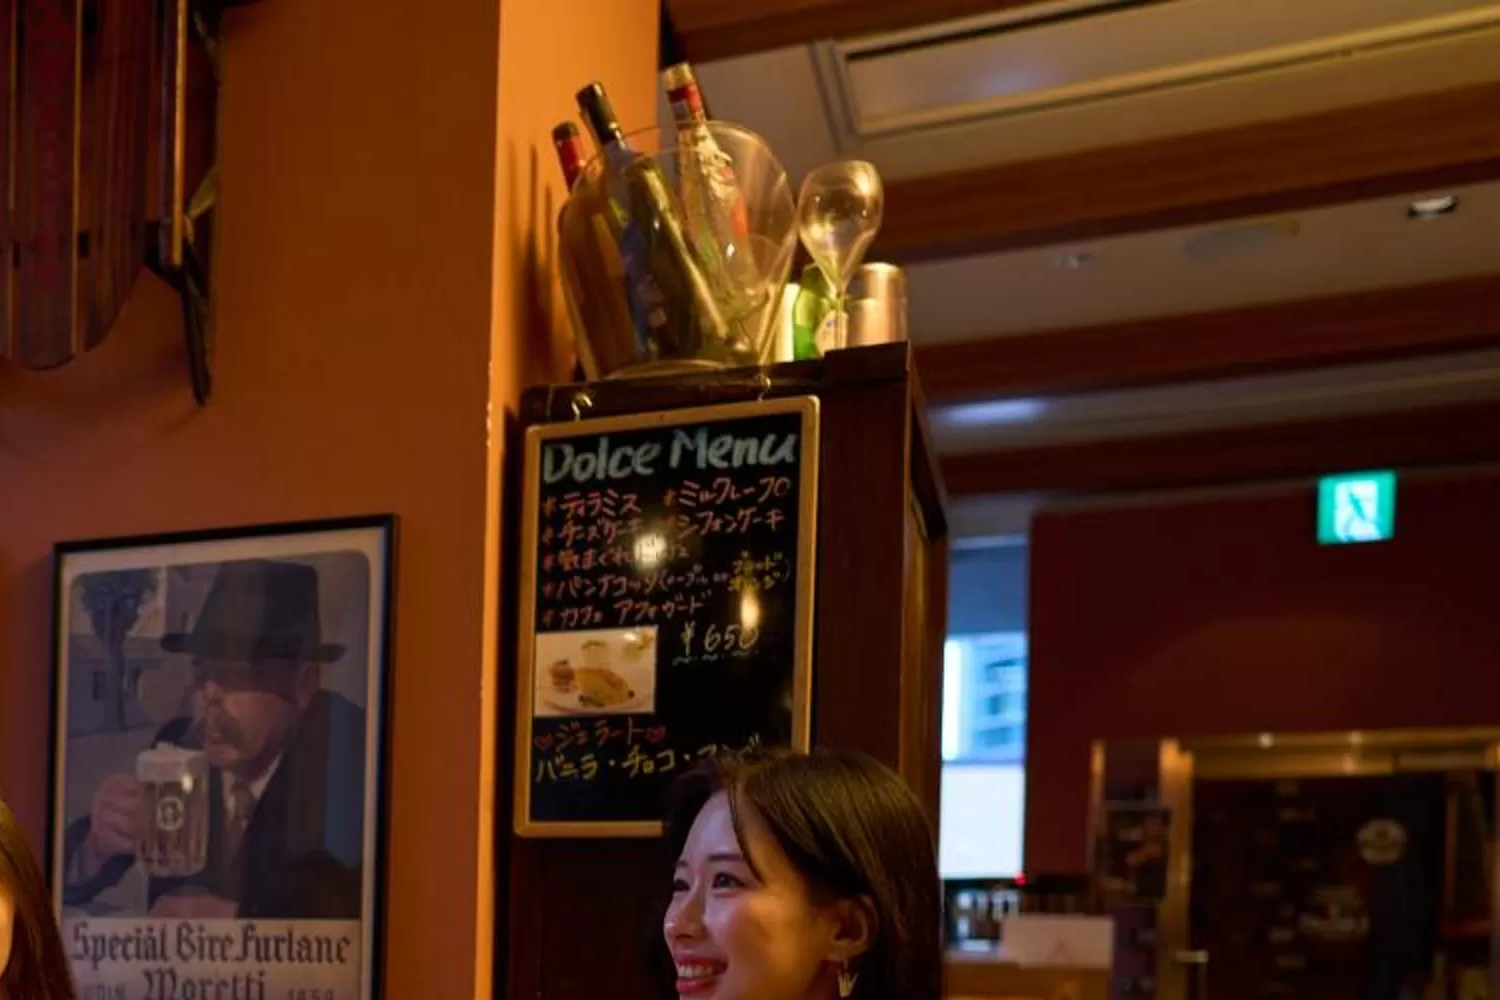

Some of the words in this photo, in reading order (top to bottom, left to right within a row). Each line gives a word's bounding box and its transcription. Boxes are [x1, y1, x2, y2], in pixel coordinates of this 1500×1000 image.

[543, 436, 661, 484] Dolce
[669, 427, 798, 469] Menu
[235, 922, 351, 964] Furlane
